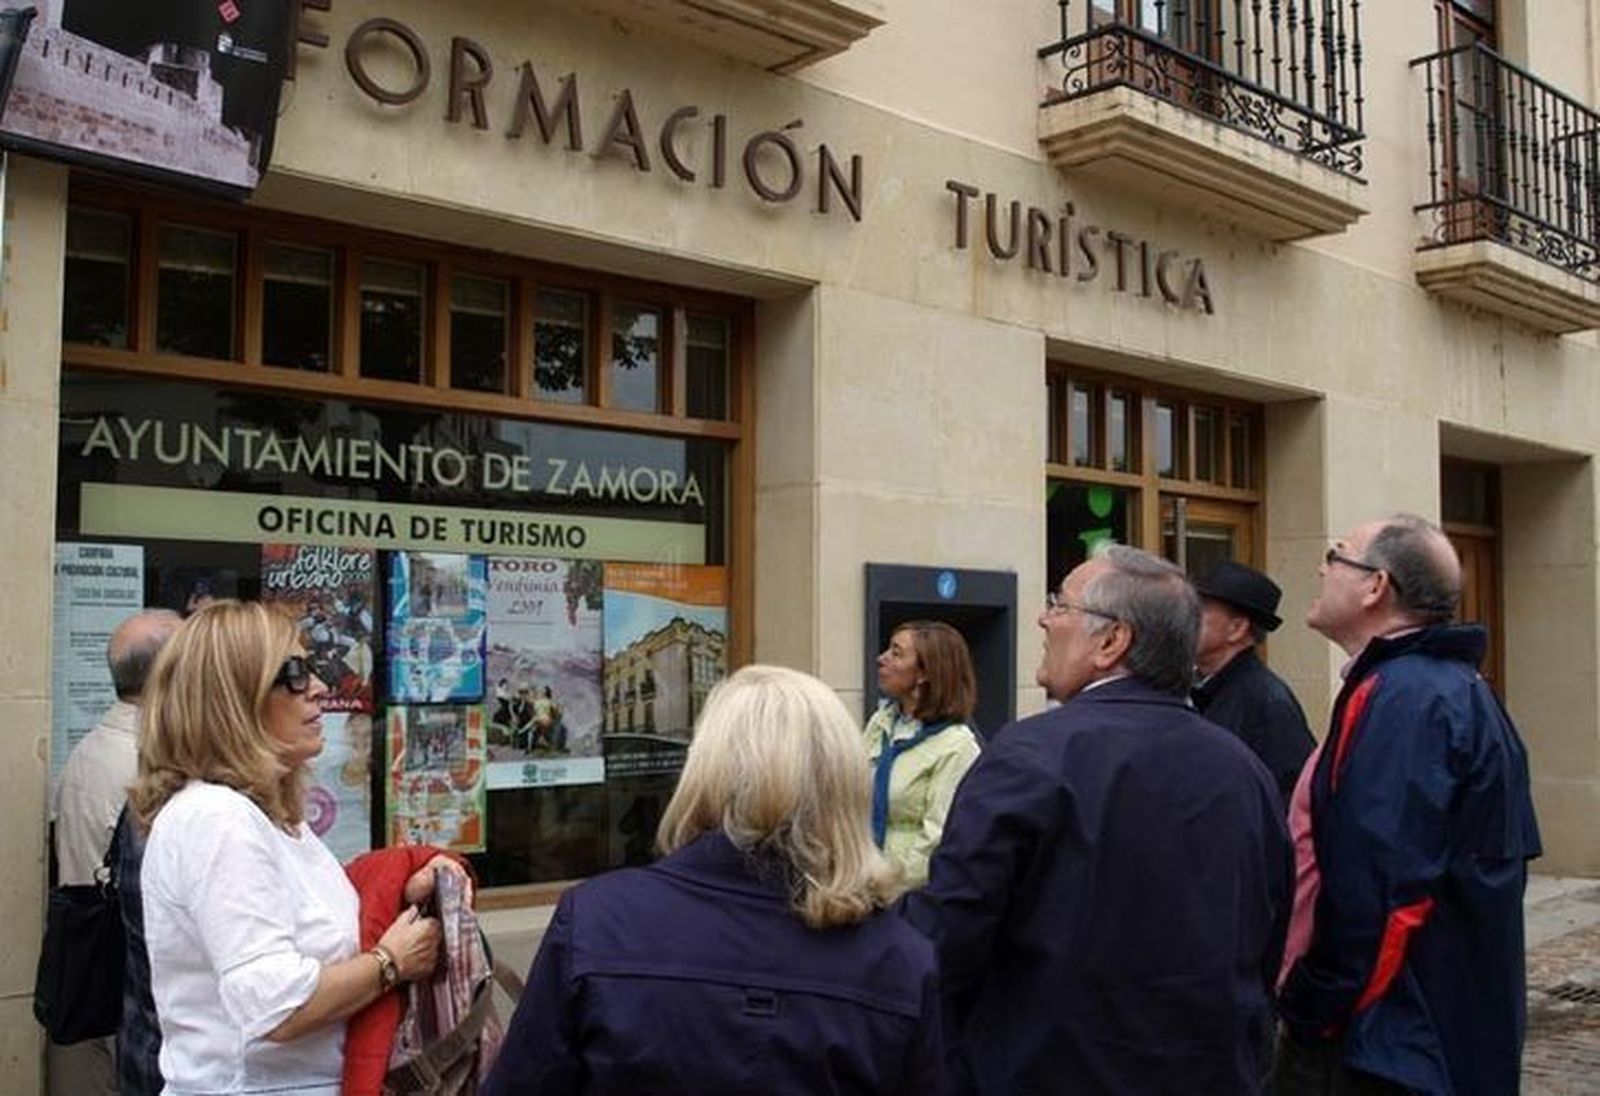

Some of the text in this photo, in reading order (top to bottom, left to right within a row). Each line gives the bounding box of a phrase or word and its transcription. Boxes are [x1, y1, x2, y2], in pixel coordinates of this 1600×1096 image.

[946, 179, 1215, 315] TURÍSTICA
[81, 415, 705, 507] AYUNTAMIENTO DE ZAMORA
[257, 505, 587, 549] OFICINA DE TURISMO
[488, 559, 557, 573] TORO
